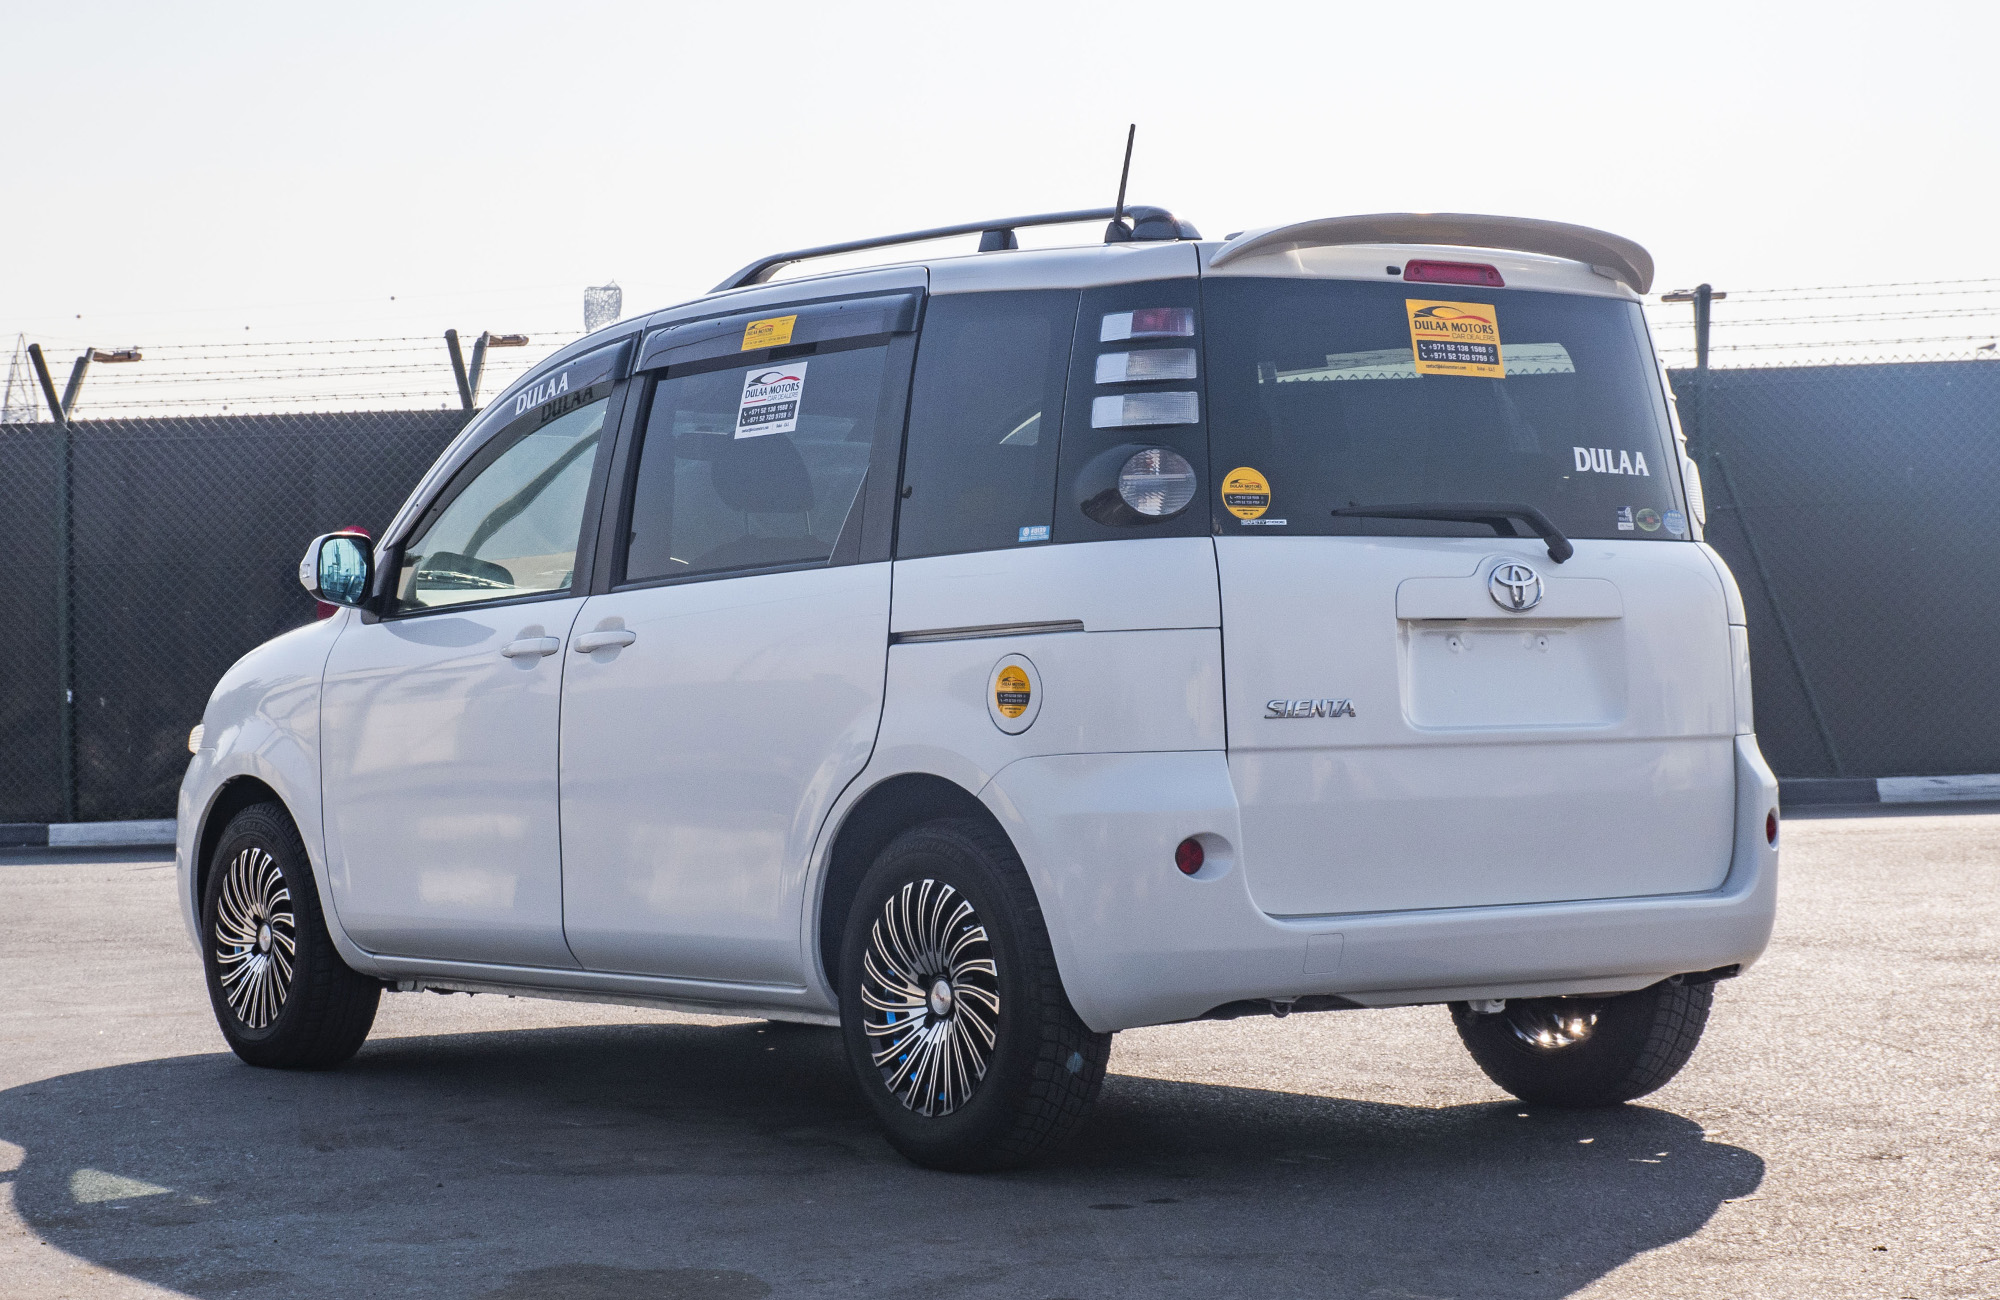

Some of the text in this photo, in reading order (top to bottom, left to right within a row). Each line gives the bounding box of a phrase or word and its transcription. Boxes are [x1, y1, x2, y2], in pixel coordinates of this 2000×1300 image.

[1414, 320, 1494, 334] DULAA MOTORS
[1458, 353, 1470, 361] 720
[515, 372, 568, 415] DULAA
[745, 382, 800, 399] DULAA MOTORS
[1573, 447, 1650, 476] DULAA
[1264, 698, 1356, 719] SIENTA
